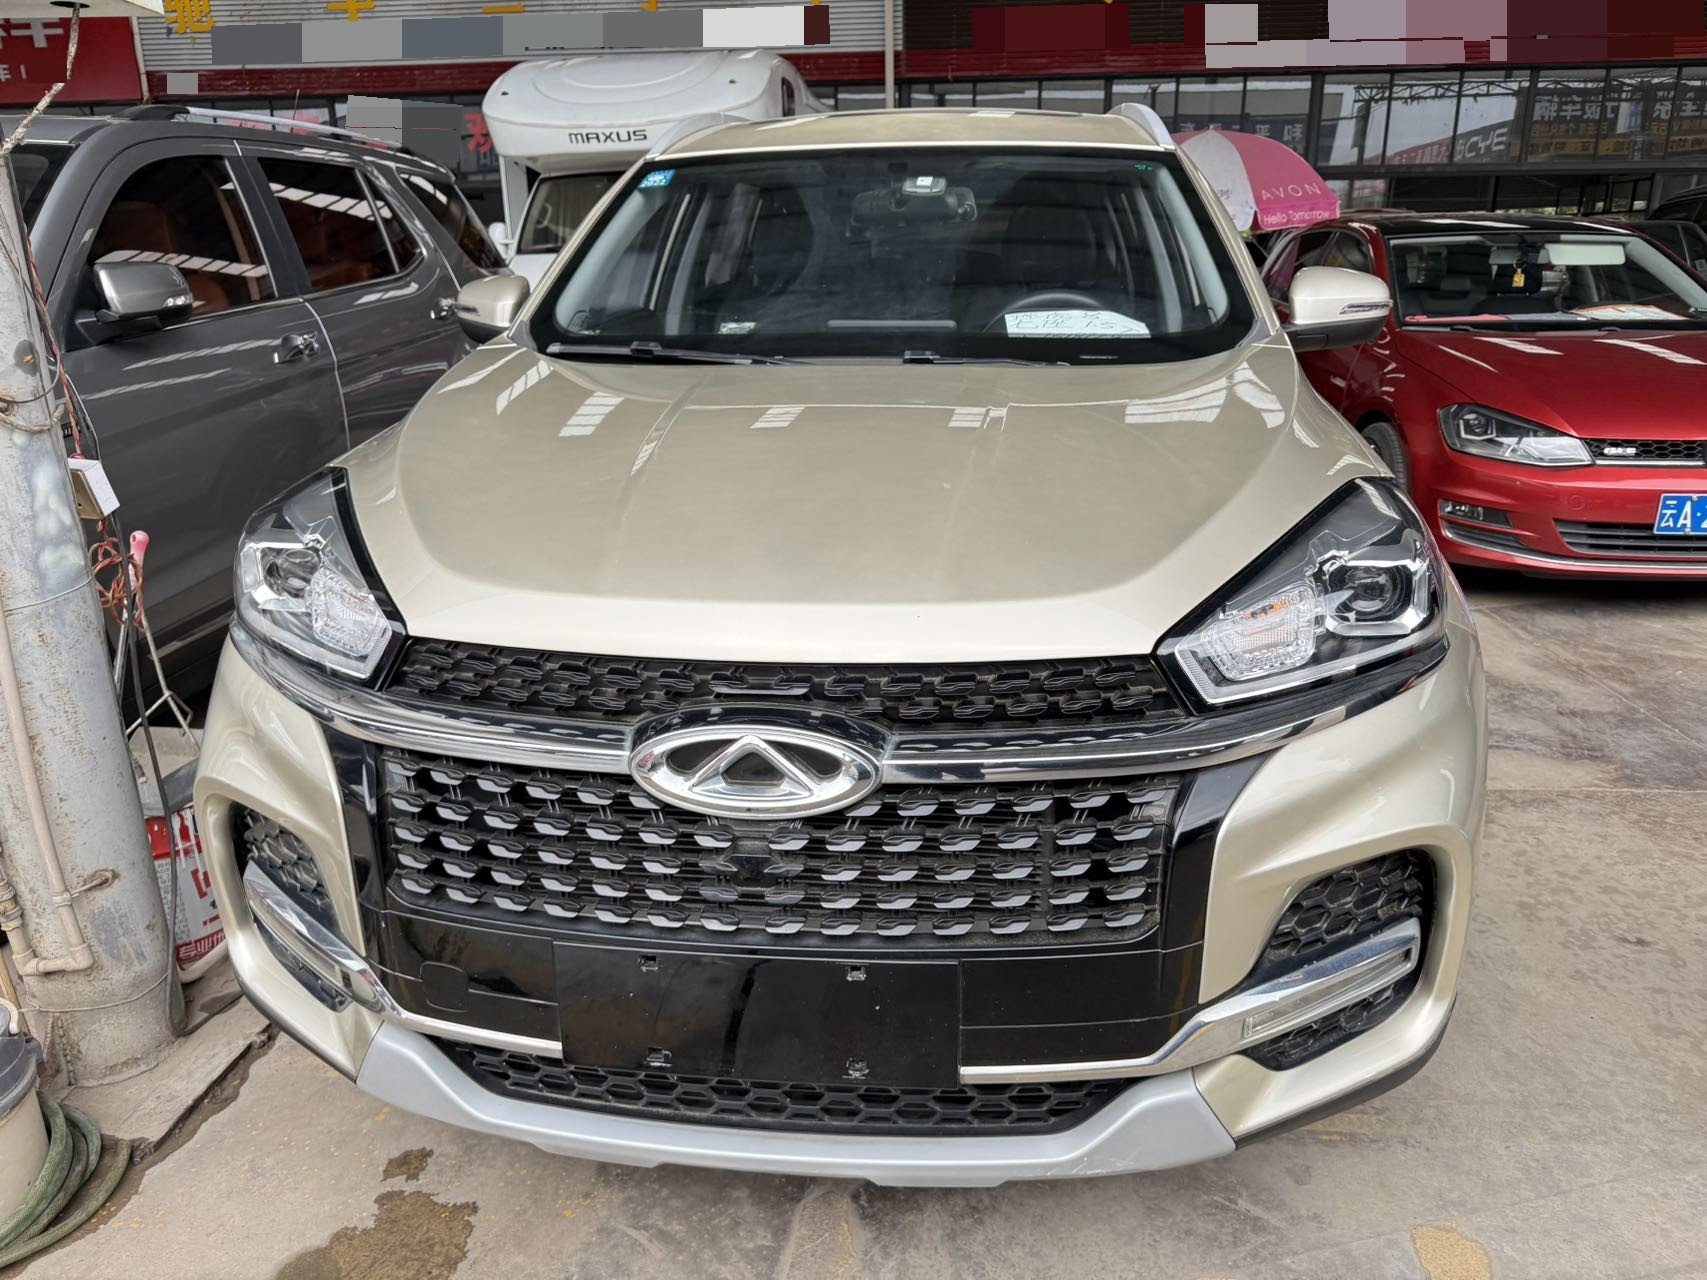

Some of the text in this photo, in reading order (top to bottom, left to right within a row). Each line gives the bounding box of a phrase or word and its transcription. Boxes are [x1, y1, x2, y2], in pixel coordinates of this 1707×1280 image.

[569, 129, 647, 144] MAXUS
[1261, 182, 1321, 201] AVON
[1263, 213, 1288, 225] Hello
